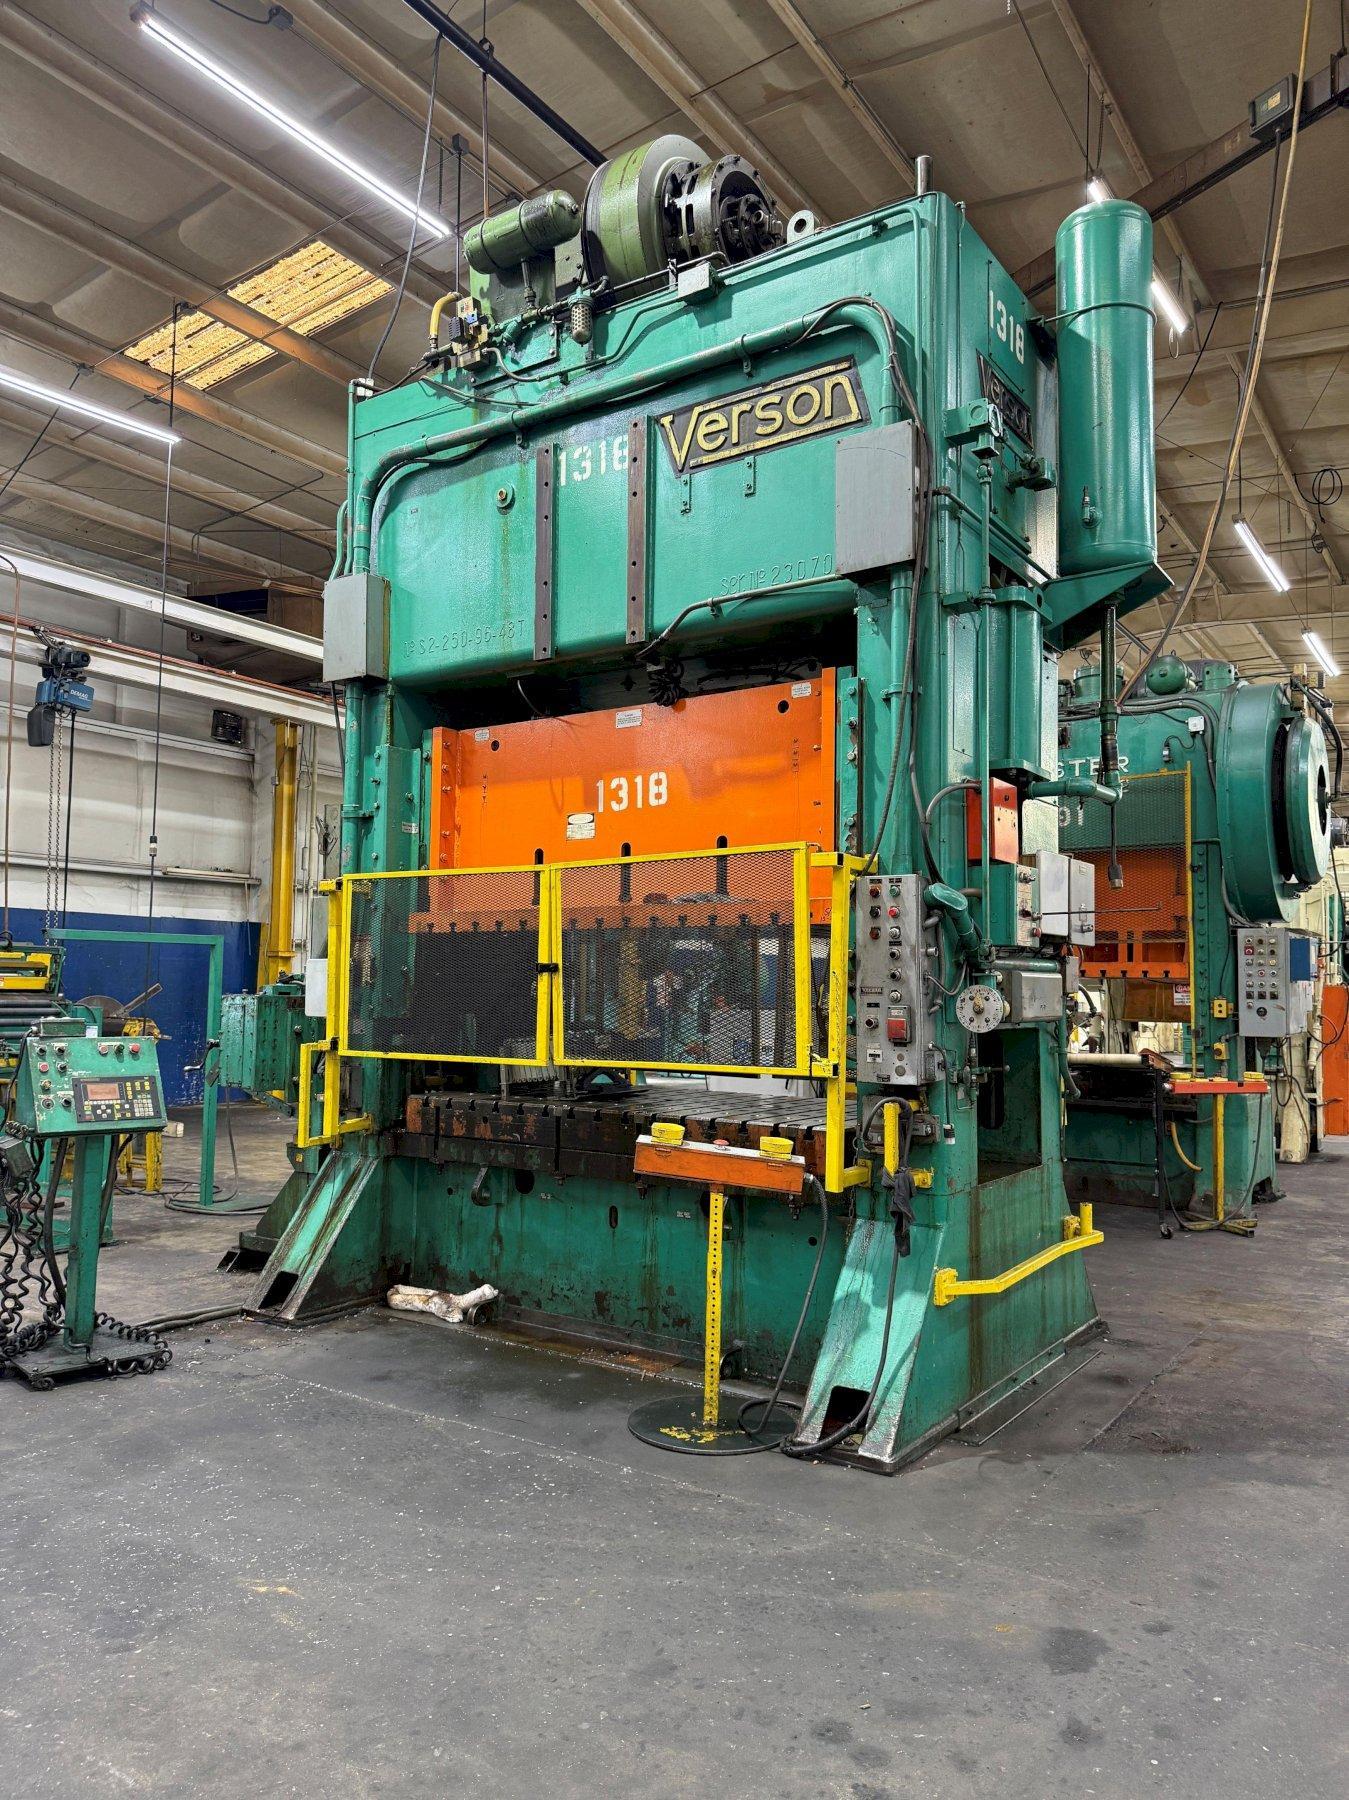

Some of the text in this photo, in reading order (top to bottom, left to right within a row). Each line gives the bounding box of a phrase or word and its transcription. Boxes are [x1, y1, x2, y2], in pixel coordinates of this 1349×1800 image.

[988, 289, 1025, 365] 1318
[660, 374, 862, 473] Verson
[558, 434, 630, 487] 1318
[770, 553, 833, 587] 23070
[596, 771, 668, 813] 1318
